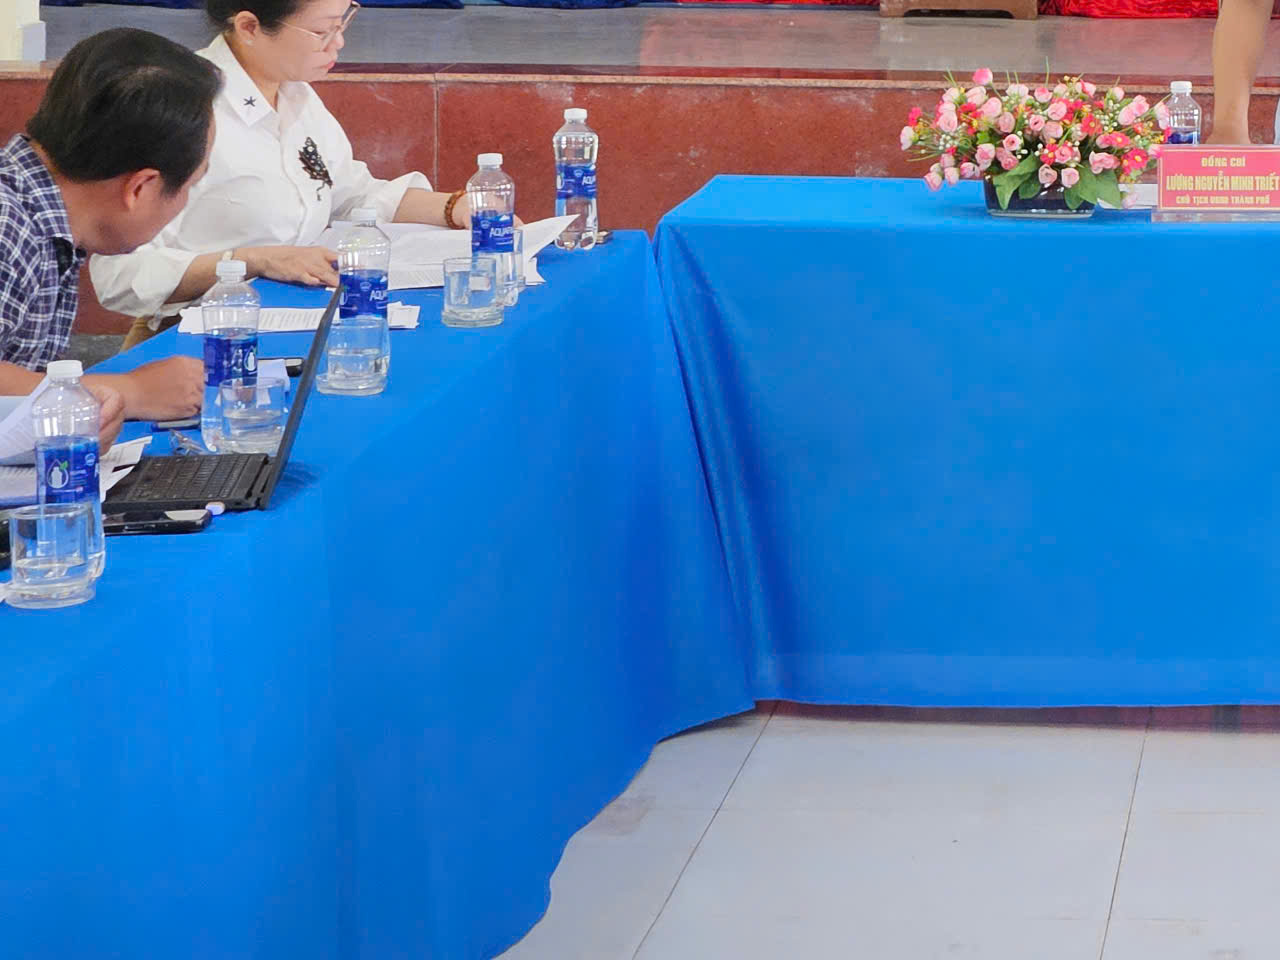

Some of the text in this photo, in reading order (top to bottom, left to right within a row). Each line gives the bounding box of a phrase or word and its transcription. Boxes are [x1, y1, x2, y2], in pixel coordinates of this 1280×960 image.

[1230, 156, 1246, 167] CHÍ
[1195, 170, 1229, 190] NGUYỄN
[1231, 175, 1254, 190] MINH
[1255, 172, 1280, 190] TRIẾT
